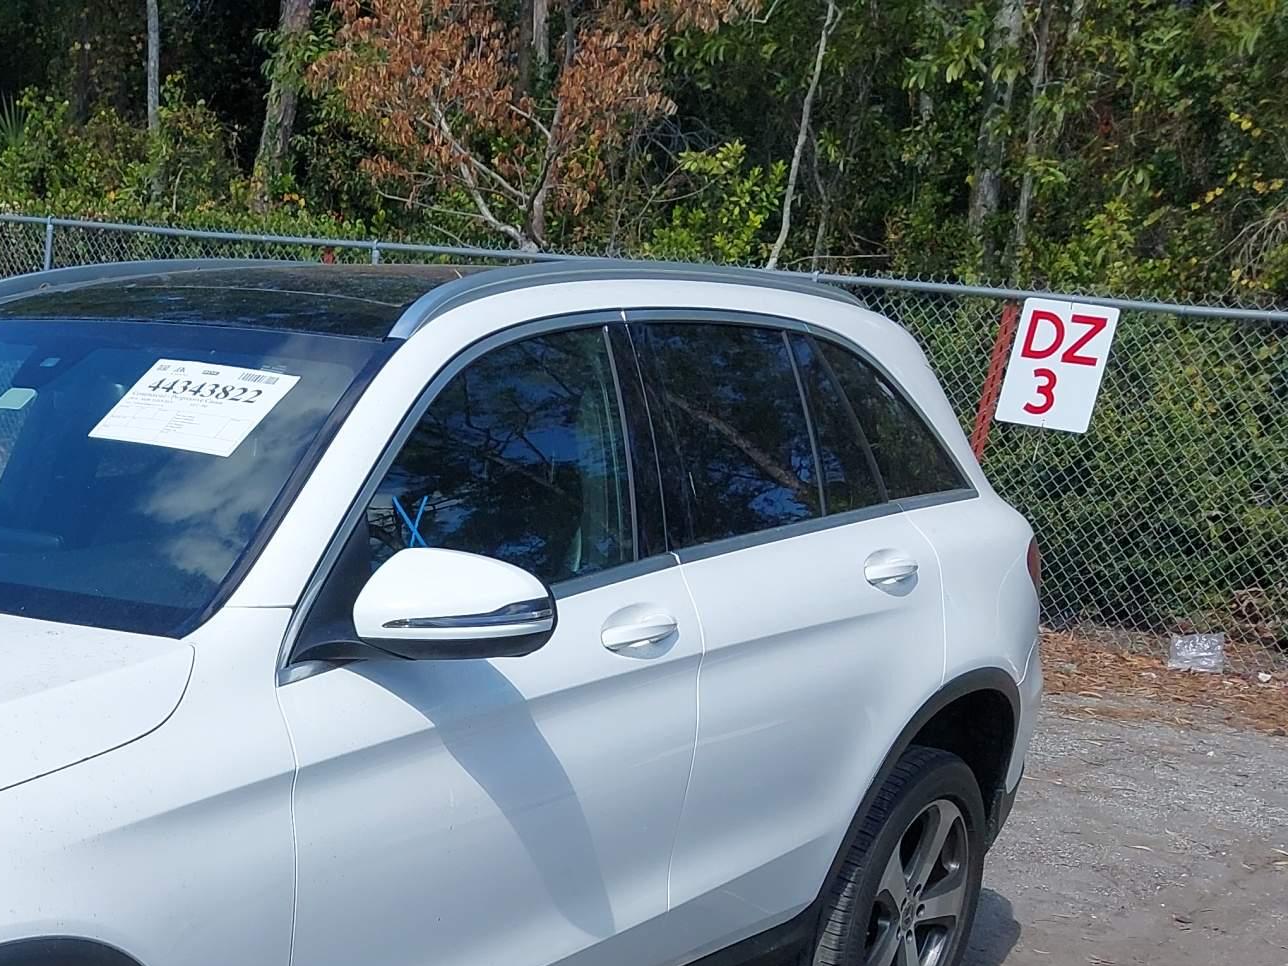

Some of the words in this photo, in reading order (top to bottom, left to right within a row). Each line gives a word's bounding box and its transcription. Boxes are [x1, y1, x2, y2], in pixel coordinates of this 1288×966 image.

[1021, 310, 1108, 366] DZ
[148, 377, 263, 404] 44343822
[1023, 368, 1057, 414] 3
